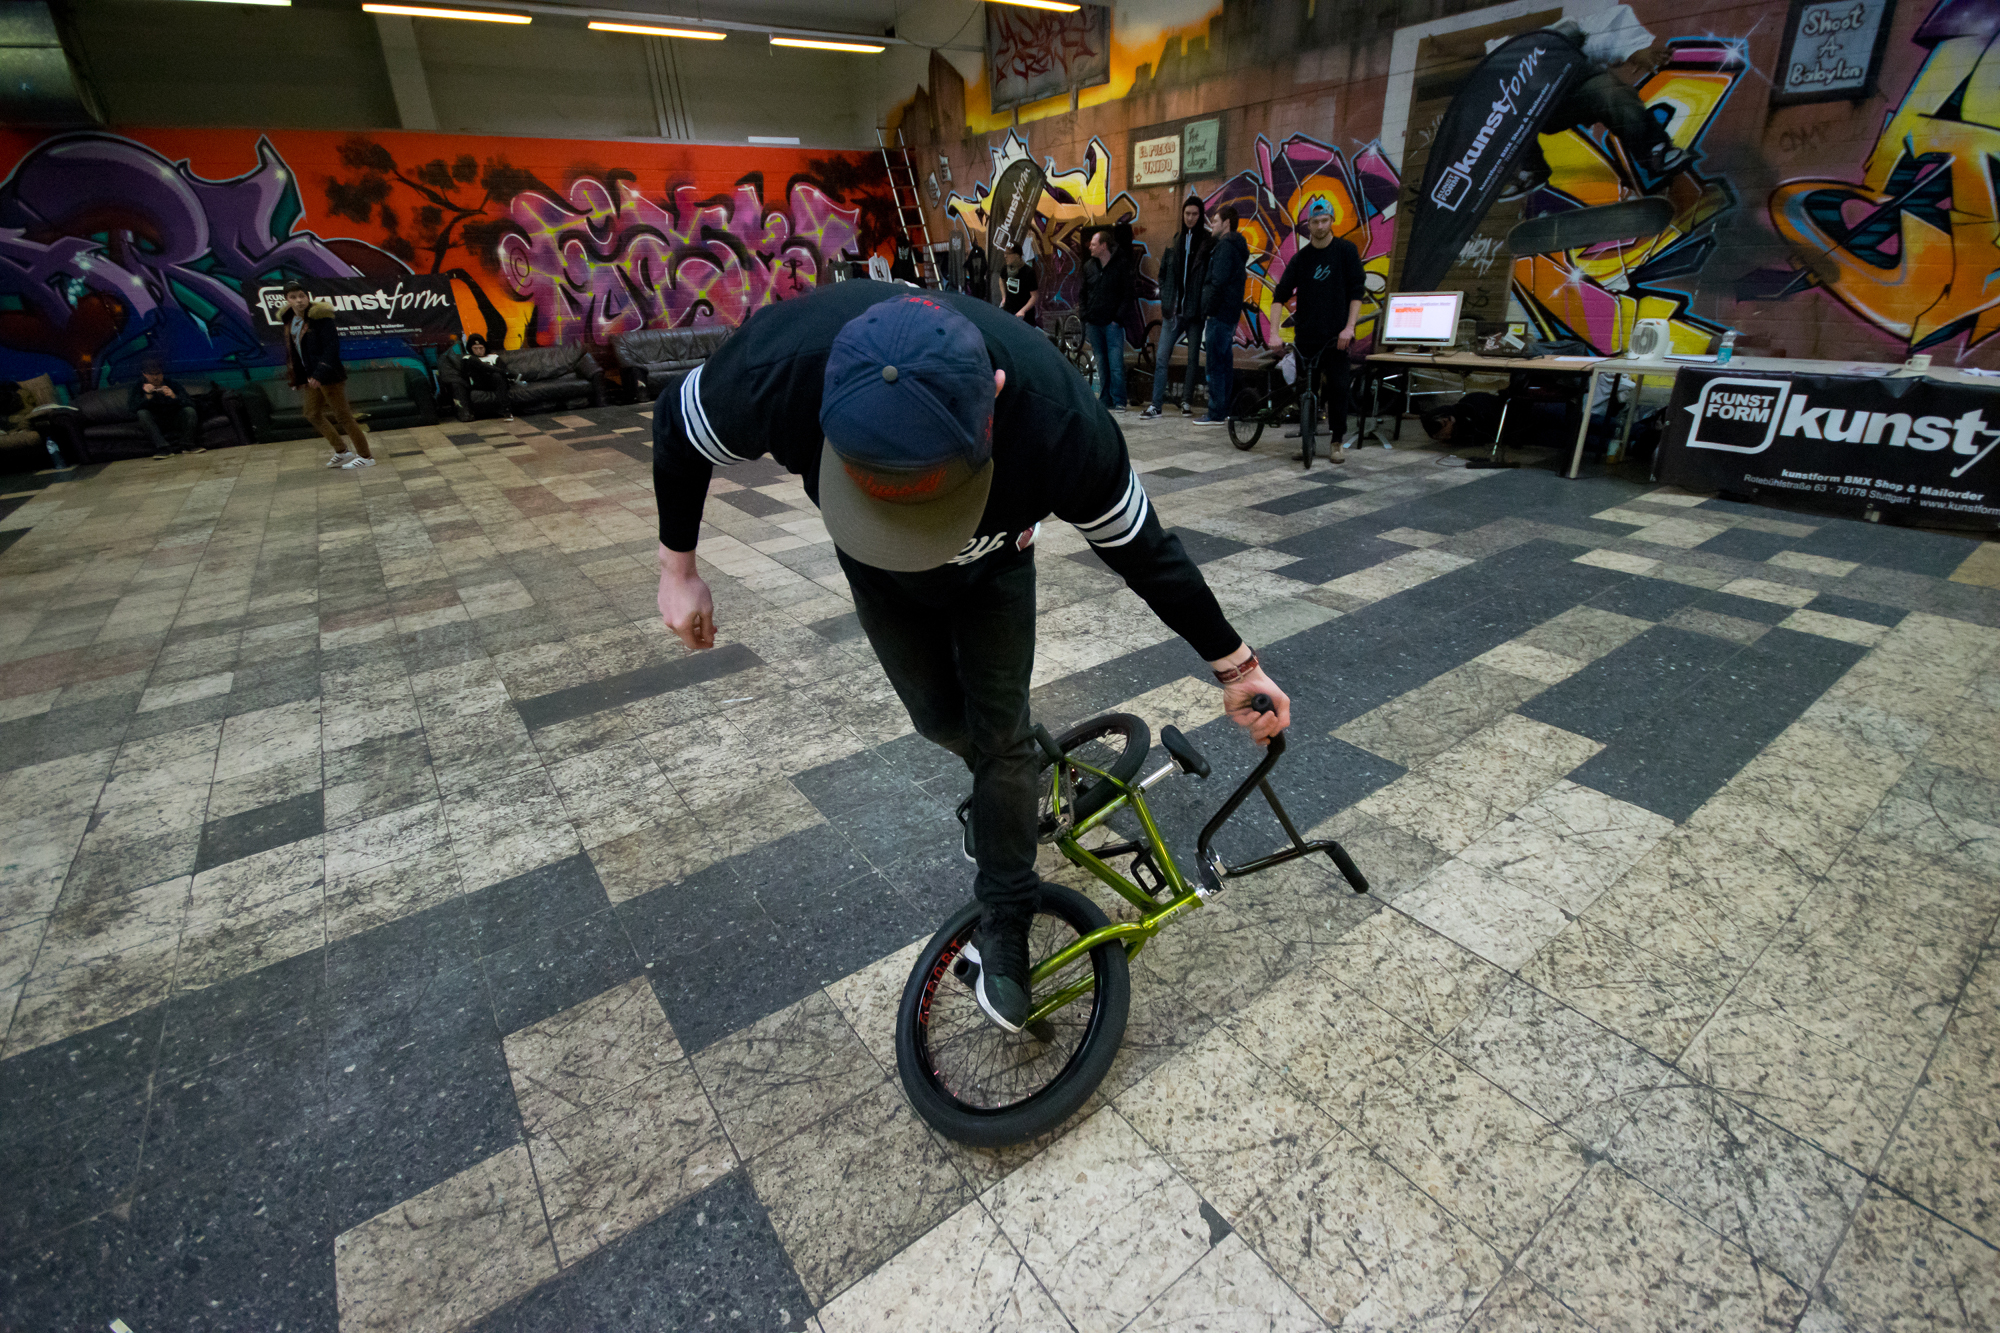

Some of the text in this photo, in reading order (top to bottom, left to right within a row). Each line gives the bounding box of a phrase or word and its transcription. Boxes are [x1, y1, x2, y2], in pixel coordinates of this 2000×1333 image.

[1803, 3, 1865, 36] Shoot
[1817, 35, 1843, 59] A
[1789, 58, 1863, 86] Babylon
[1453, 46, 1547, 174] kunstform
[1143, 158, 1173, 175] UNIDO
[1705, 403, 1771, 423] FORM
[1709, 391, 1774, 408] KUNST
[1743, 474, 1811, 491] Rotebühlstraße
[1813, 483, 1827, 492] 63
[1836, 485, 1867, 497] 70178
[1869, 490, 1911, 504] Stuttgart
[1781, 469, 1985, 501] kunstform BMX Shop & Mailorder
